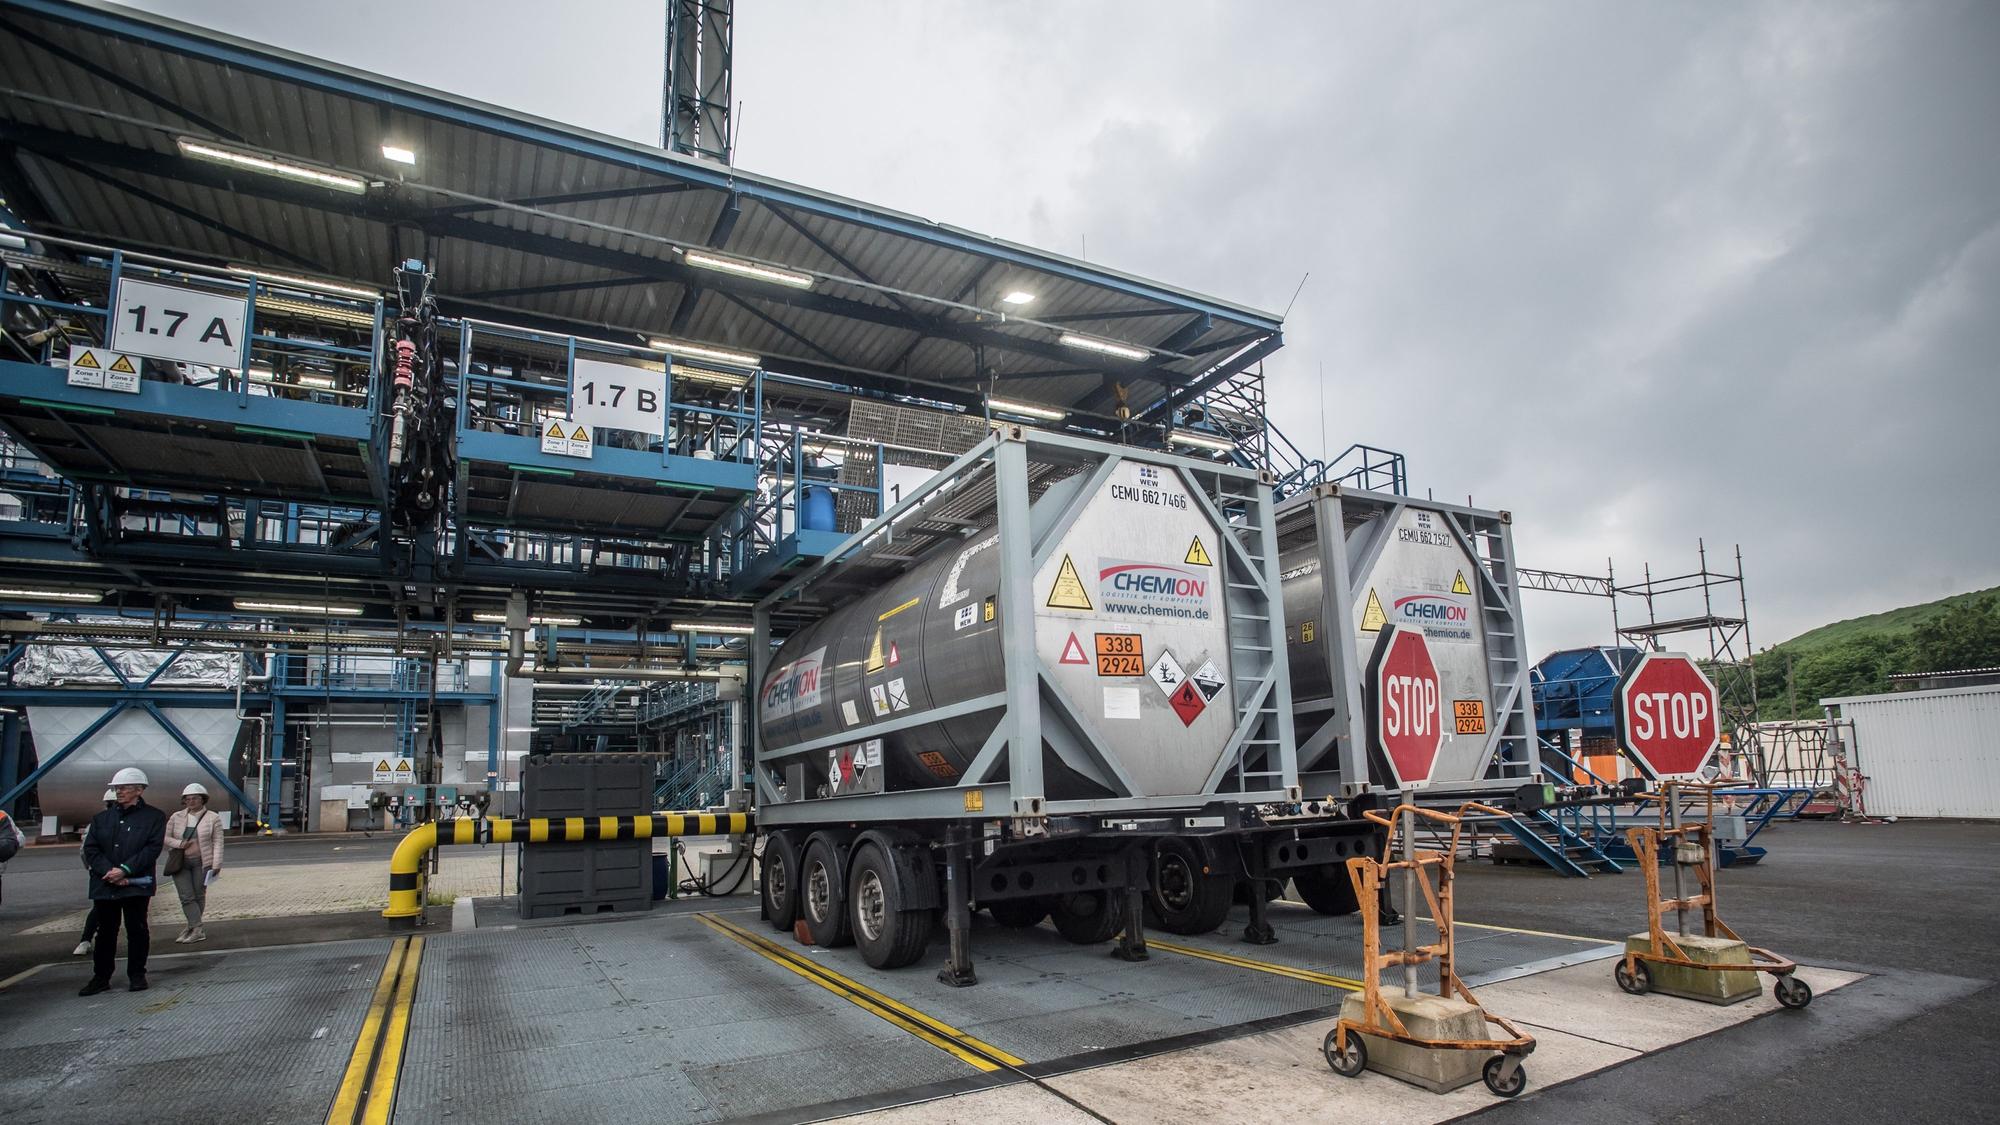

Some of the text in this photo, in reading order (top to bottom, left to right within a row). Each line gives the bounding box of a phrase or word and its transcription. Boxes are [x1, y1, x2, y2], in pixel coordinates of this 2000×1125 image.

[128, 305, 233, 347] 1.7 A
[75, 369, 93, 377] Zone
[110, 373, 128, 381] Zone
[582, 381, 658, 414] 1.7 B
[1139, 479, 1159, 488] WEW
[1111, 484, 1187, 509] CEMU 662 7466
[1418, 522, 1432, 530] WEW
[1400, 528, 1452, 547] CEMU 662 7527
[1114, 573, 1206, 597] CHEMION
[1101, 591, 1138, 600] LOGISTIK
[1105, 602, 1209, 620] www.chemion.de
[1404, 602, 1467, 621] CHEMION
[1424, 627, 1471, 640] chemion.de
[1104, 637, 1134, 653] 338
[1102, 658, 1140, 674] 2924
[767, 666, 819, 708] CHEMION
[1387, 674, 1436, 737] STOP
[1459, 703, 1479, 716] 338
[1634, 692, 1708, 740] STOP
[1458, 719, 1483, 732] 2924
